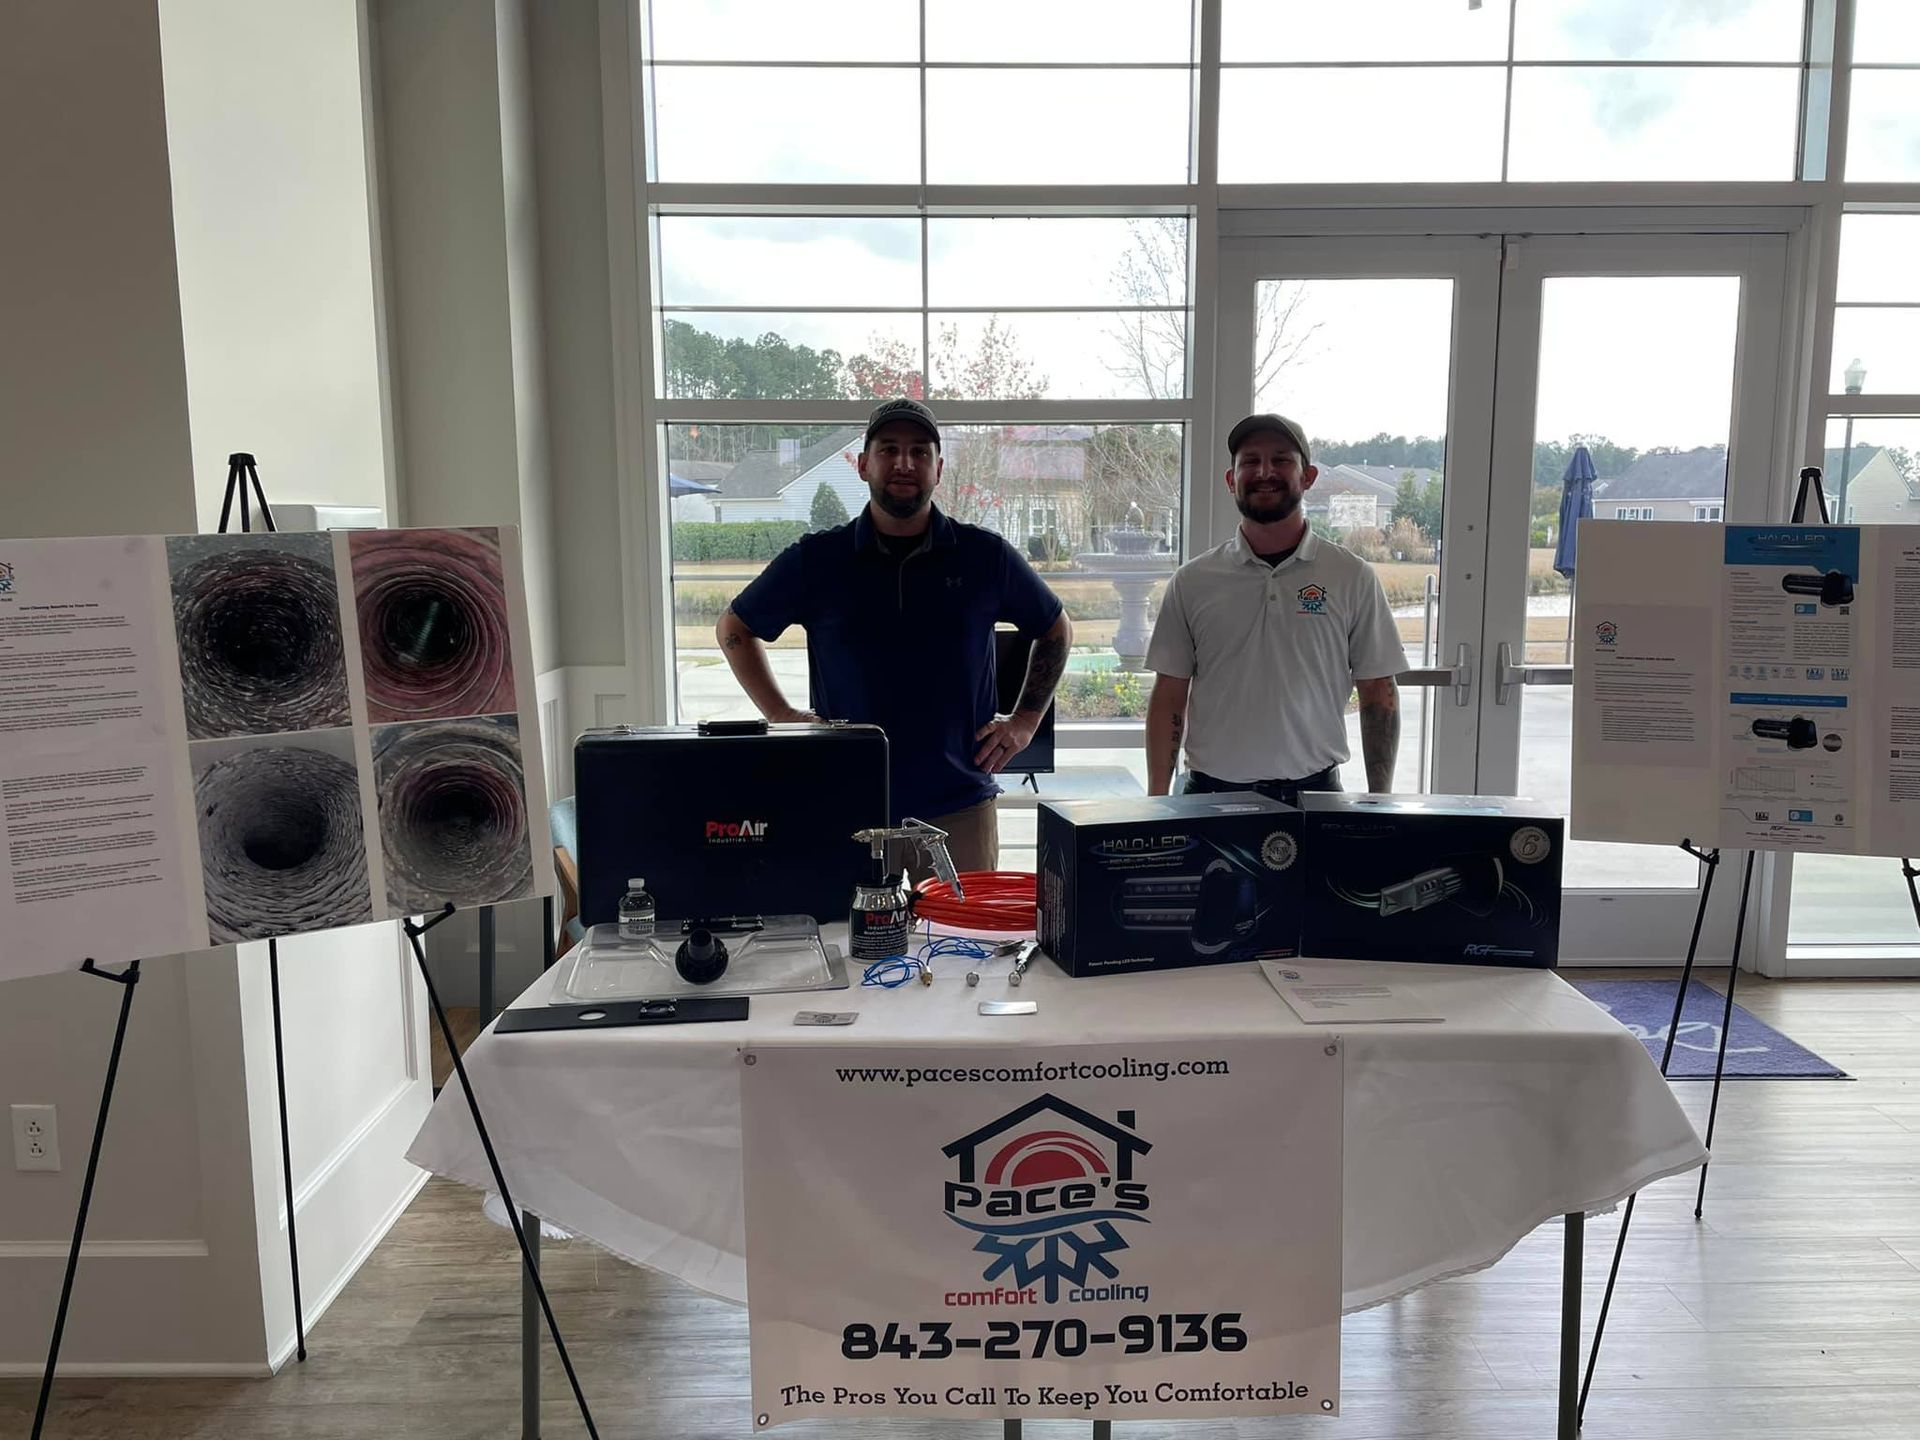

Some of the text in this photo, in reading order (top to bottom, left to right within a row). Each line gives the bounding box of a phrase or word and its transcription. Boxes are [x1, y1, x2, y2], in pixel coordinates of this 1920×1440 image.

[705, 819, 769, 838] ProAir
[836, 1057, 1230, 1088] www.pacescomfortcooling.com
[944, 1176, 1151, 1218] Pace's
[944, 1283, 1149, 1306] comfort cooling
[841, 1312, 1248, 1360] 843-270-9136
[780, 1380, 1309, 1410] The Pros You Call To Keep You Comfortable
